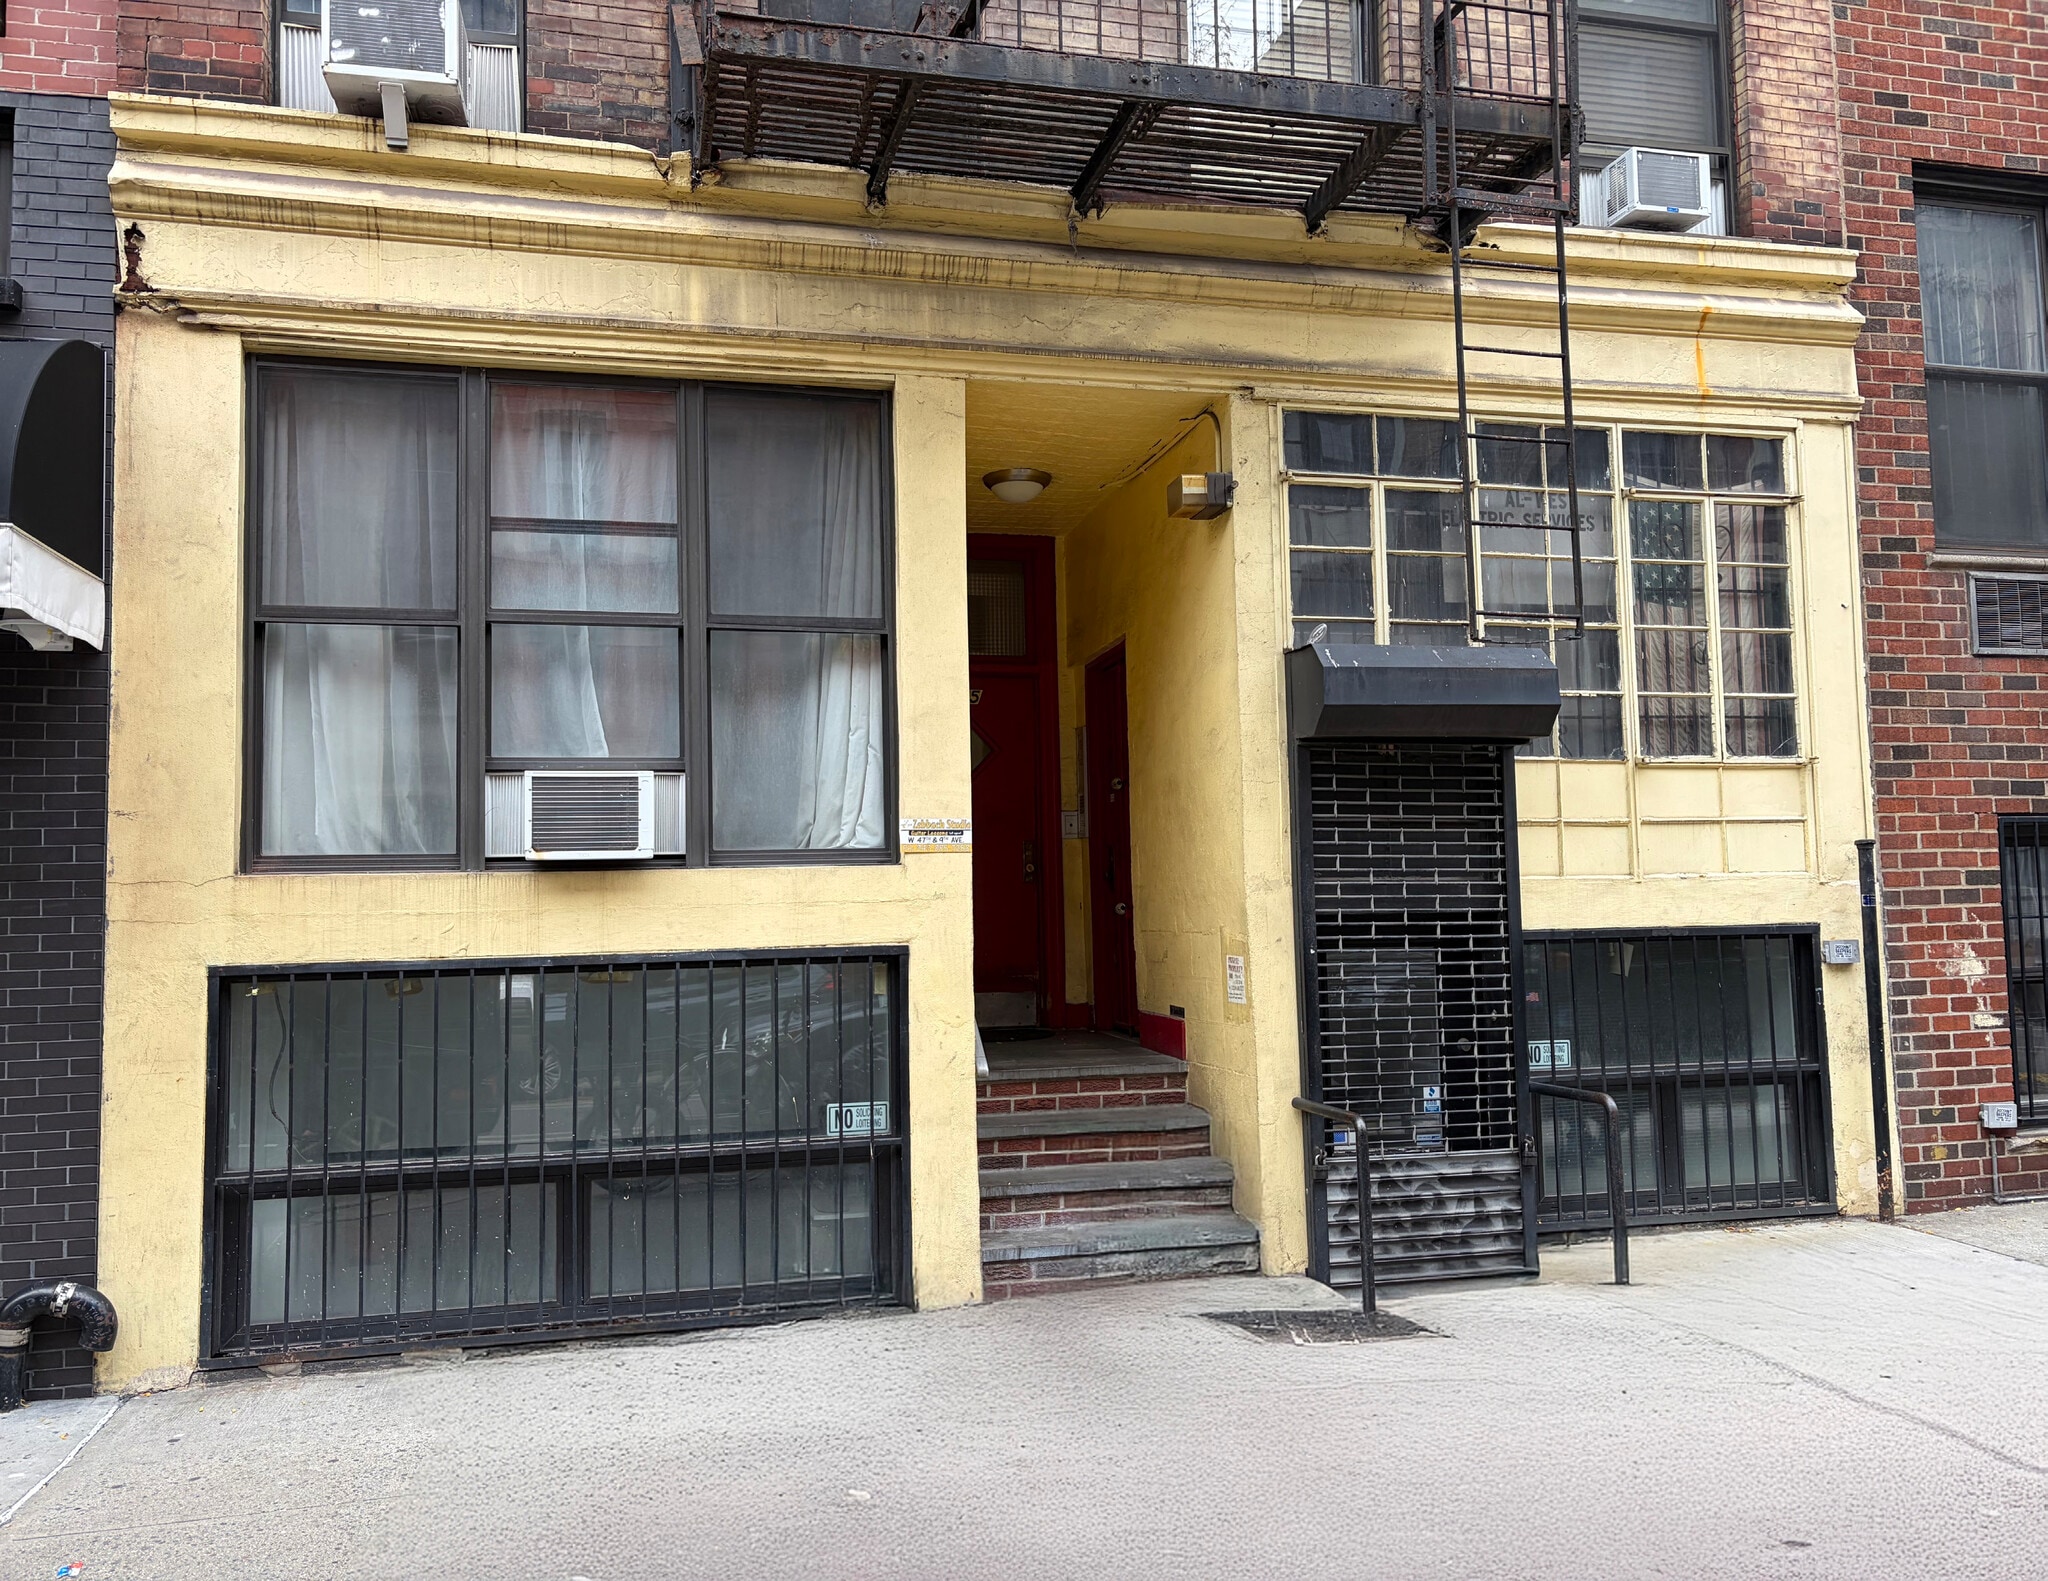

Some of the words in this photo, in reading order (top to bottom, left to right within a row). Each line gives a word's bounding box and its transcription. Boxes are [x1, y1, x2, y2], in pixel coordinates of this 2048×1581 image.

[1441, 510, 1515, 529] ELTRIC
[1523, 512, 1595, 532] SEVICES
[835, 1108, 853, 1129] NO
[855, 1107, 883, 1118] SOLICING
[855, 1117, 882, 1128] LOITENG
